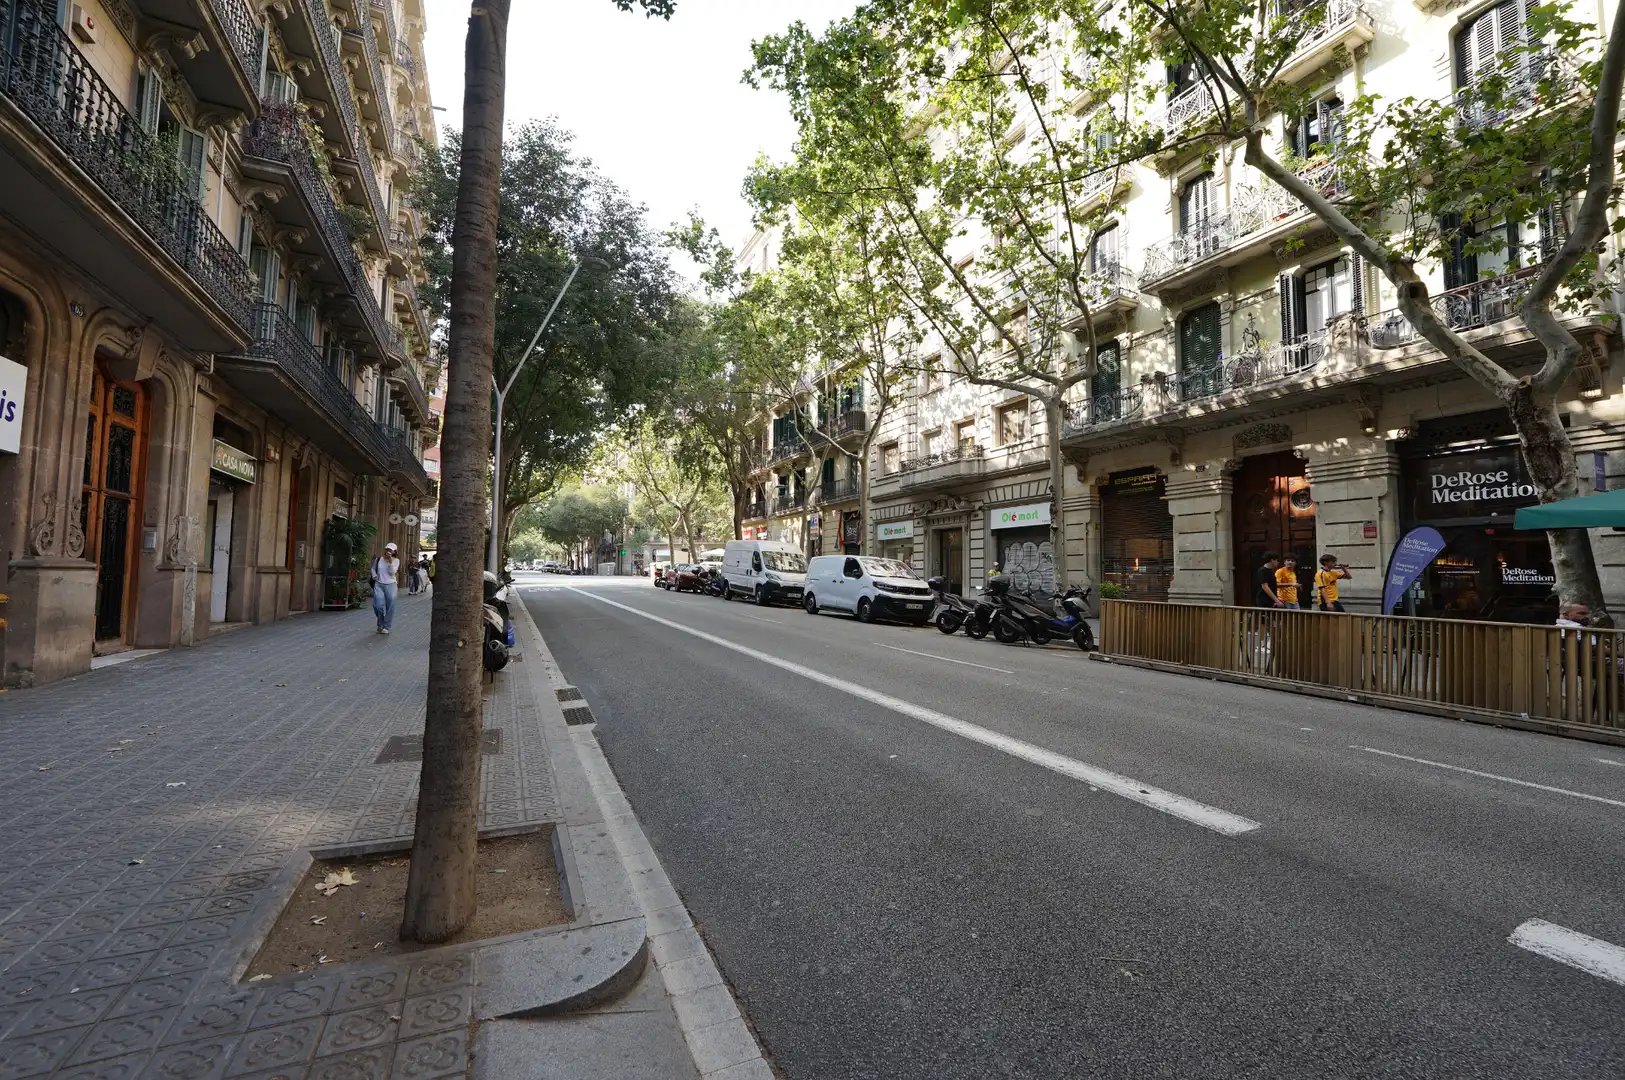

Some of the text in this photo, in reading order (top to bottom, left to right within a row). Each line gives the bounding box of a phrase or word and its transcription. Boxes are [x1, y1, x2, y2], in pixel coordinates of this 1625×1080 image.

[222, 453, 254, 477] CASA NOVA
[1432, 470, 1509, 489] DeRose
[1001, 510, 1039, 523] Olé mart
[1403, 542, 1438, 554] Meditation
[1502, 567, 1537, 575] DeRose
[1502, 574, 1554, 582] Meditation
